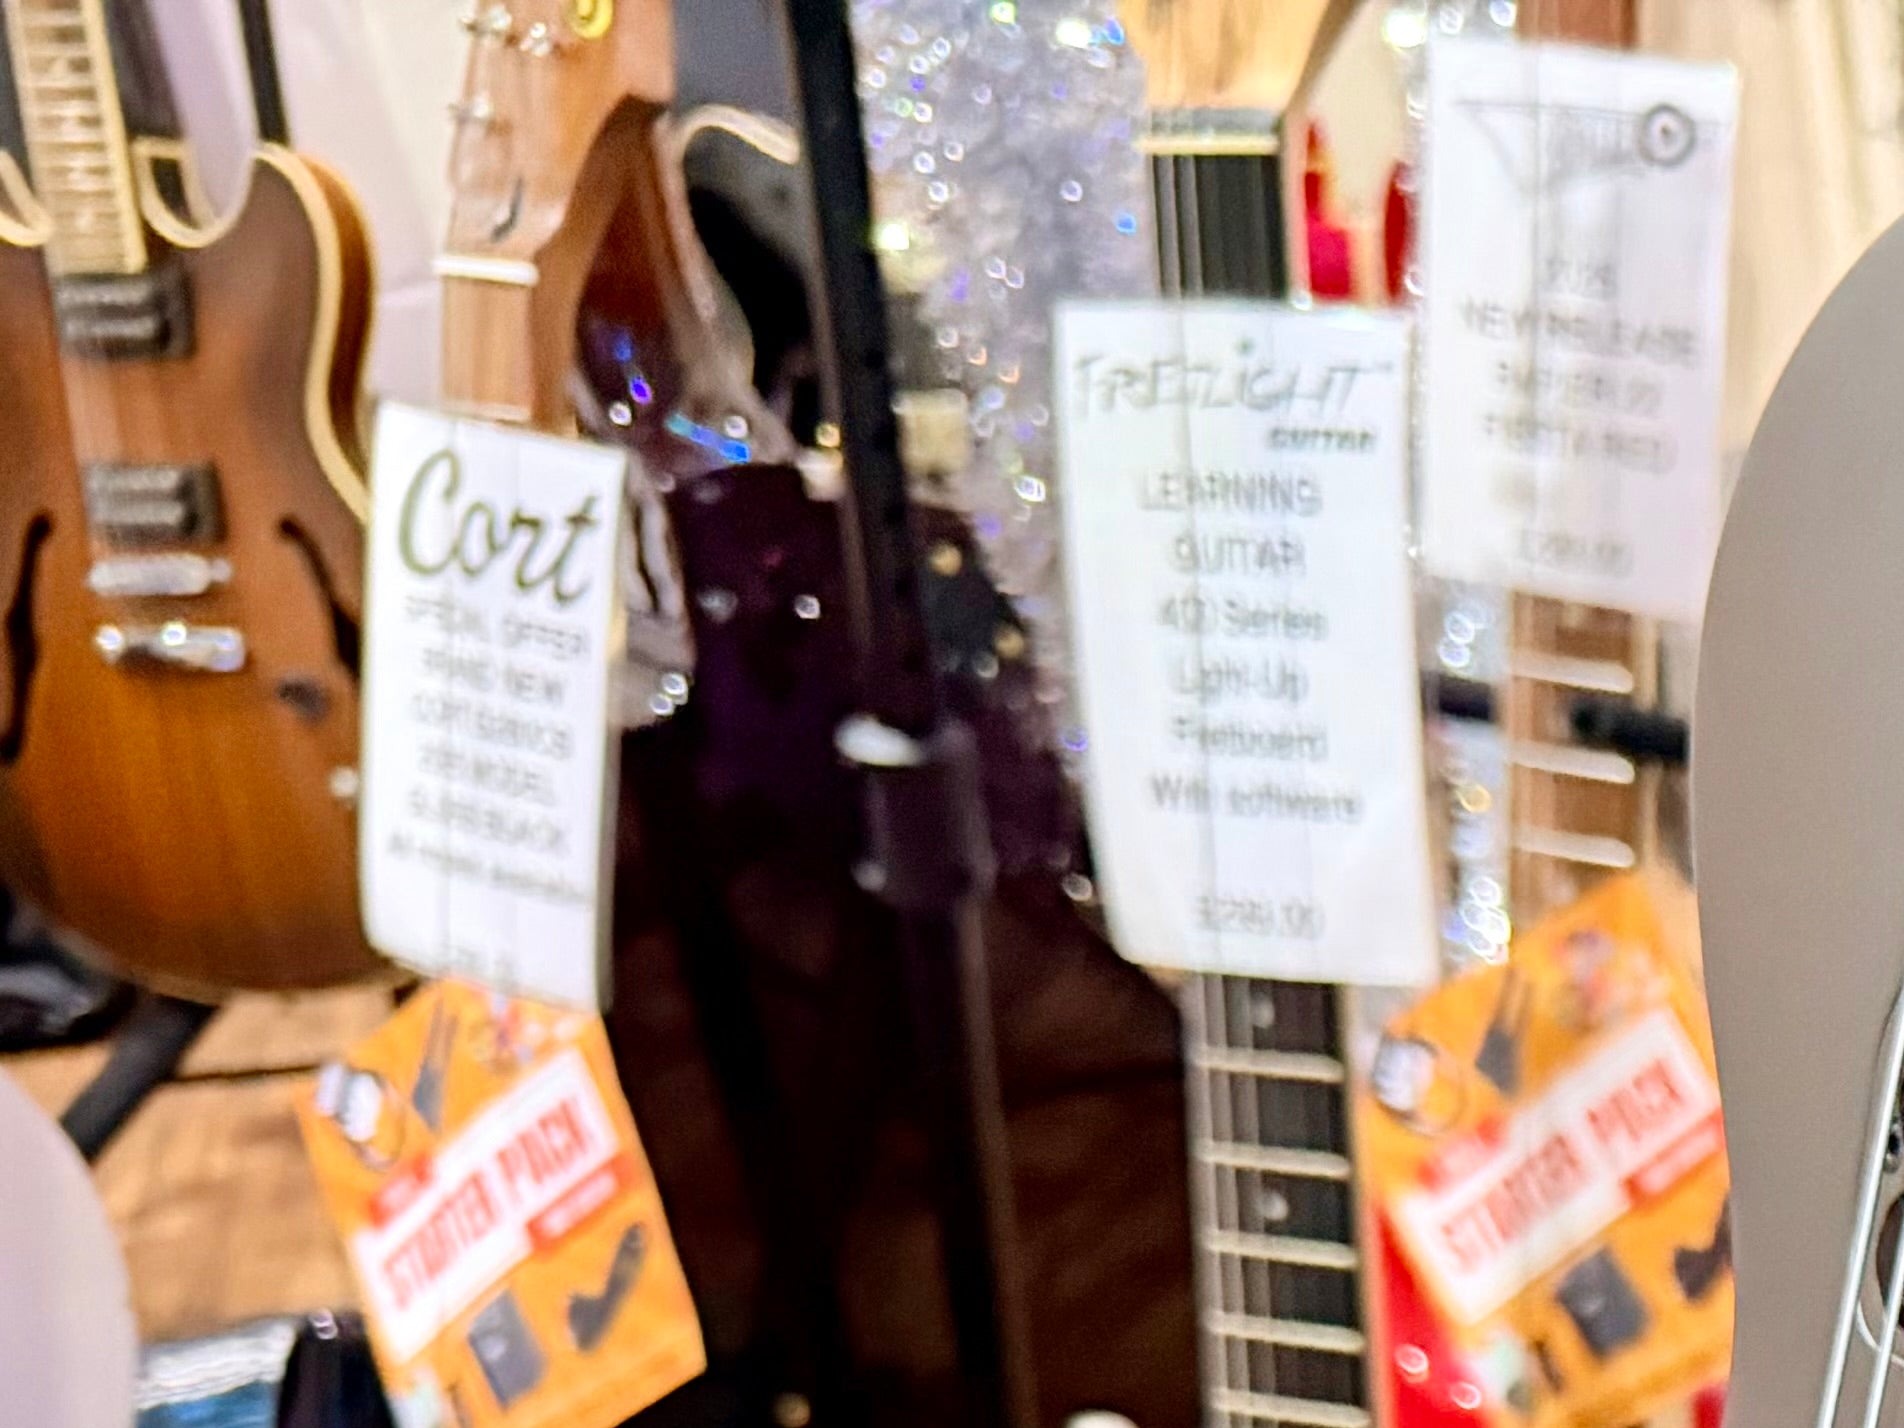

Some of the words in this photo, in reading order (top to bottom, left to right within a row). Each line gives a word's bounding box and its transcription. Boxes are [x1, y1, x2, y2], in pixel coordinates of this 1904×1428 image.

[399, 446, 602, 608] Cort
[1138, 471, 1324, 517] LEARNING
[1168, 534, 1306, 577] GUITAR
[383, 1168, 496, 1310] STARTER
[495, 1096, 592, 1208] PACK
[1441, 1131, 1590, 1276] STARTER
[1586, 1060, 1684, 1152] PACK
